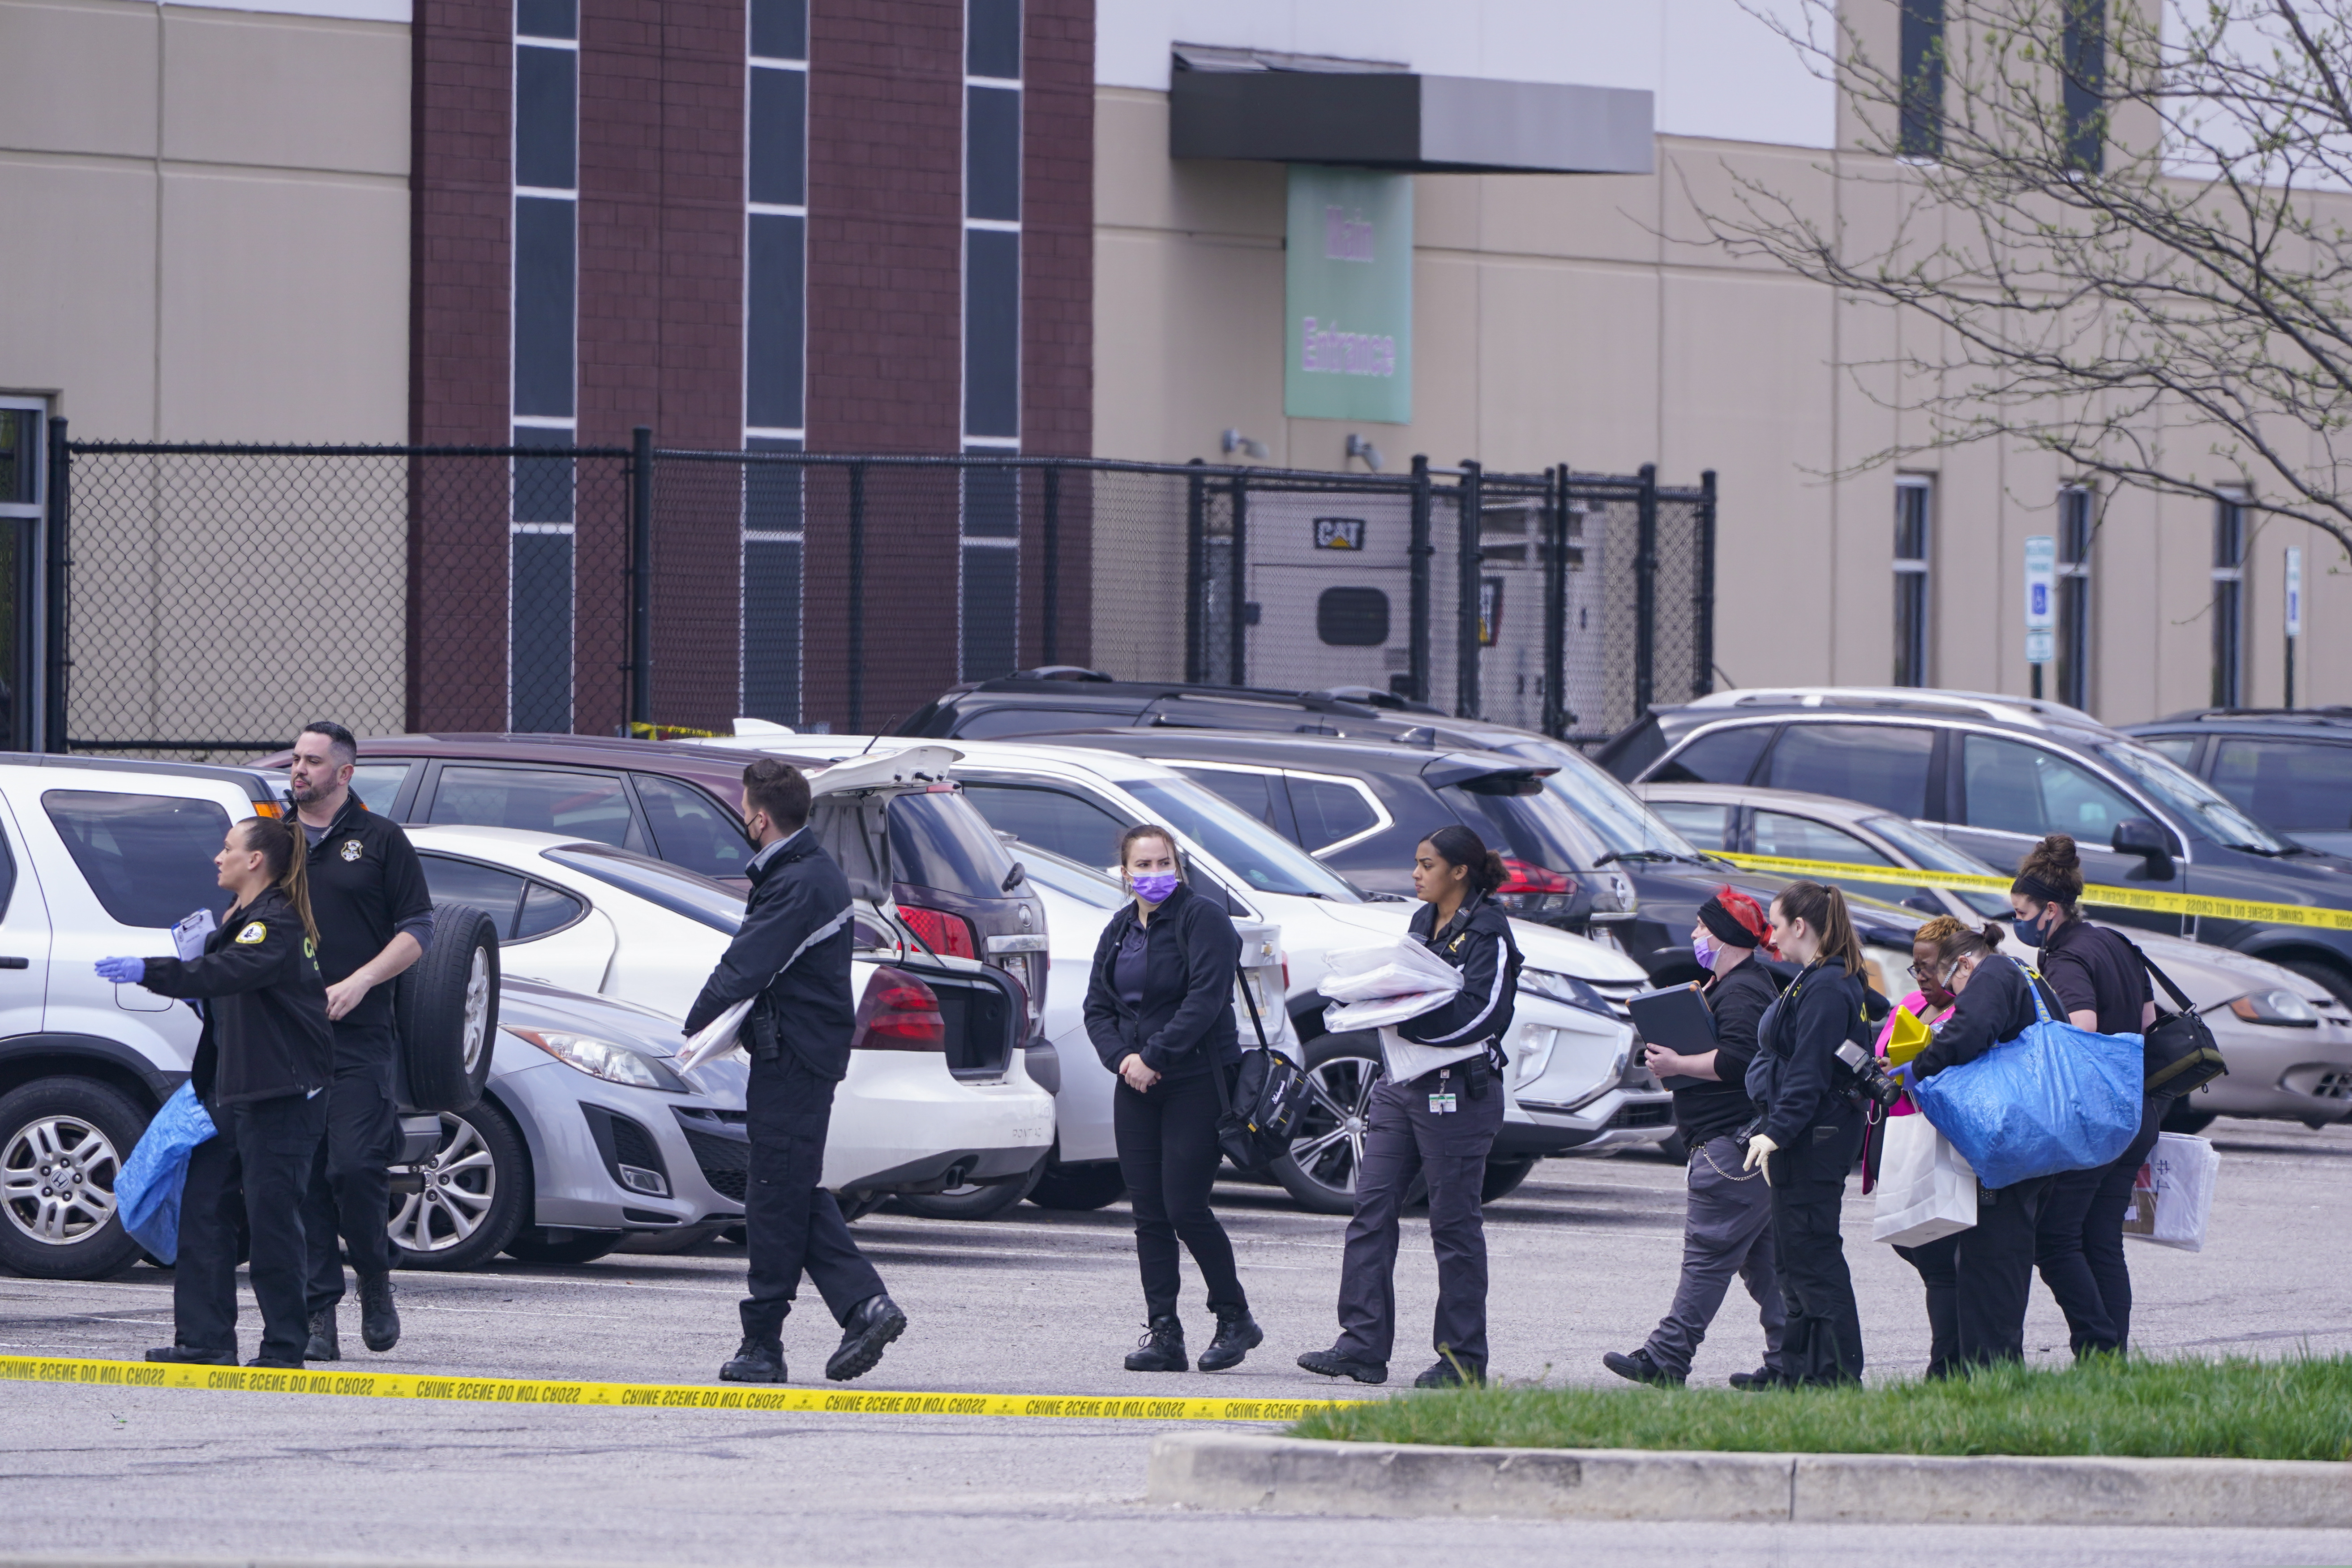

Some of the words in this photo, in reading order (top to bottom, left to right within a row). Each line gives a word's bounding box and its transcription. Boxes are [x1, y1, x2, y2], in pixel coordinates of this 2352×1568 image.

[1302, 317, 1395, 377] Entrance
[1317, 521, 1360, 548] CAT
[2035, 999, 2050, 1023] IKEA
